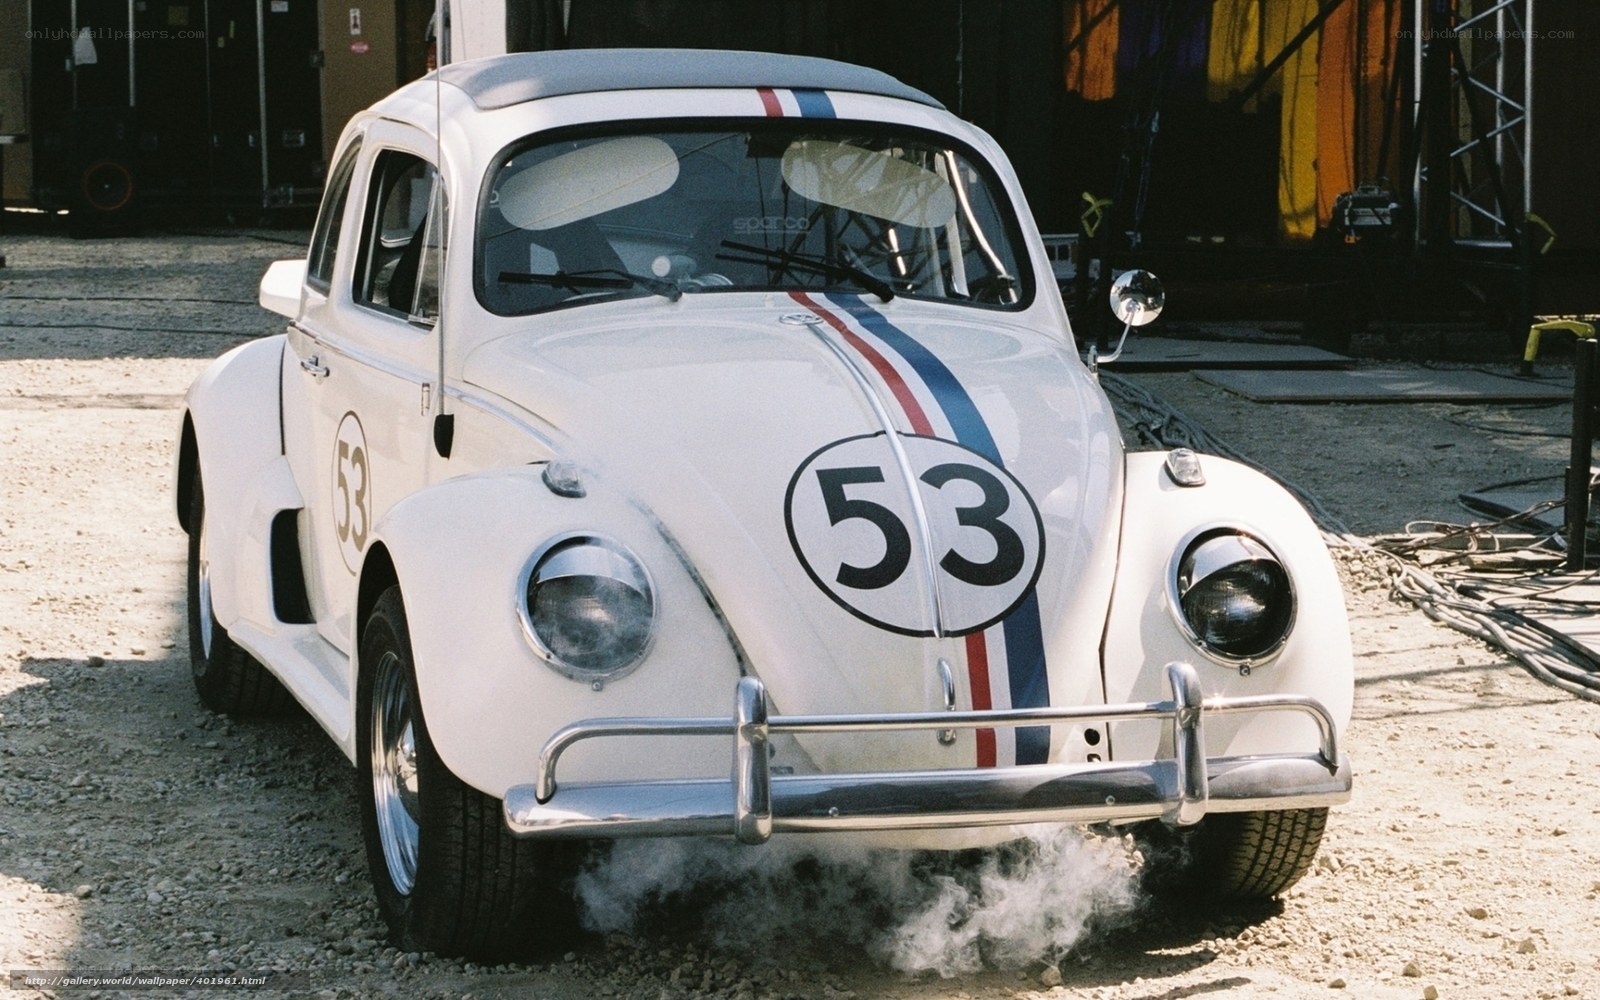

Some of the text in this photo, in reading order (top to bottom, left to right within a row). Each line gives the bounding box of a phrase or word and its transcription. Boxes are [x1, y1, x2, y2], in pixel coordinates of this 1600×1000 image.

[733, 216, 810, 234] sparco
[337, 439, 368, 552] 53
[815, 462, 1025, 589] 53
